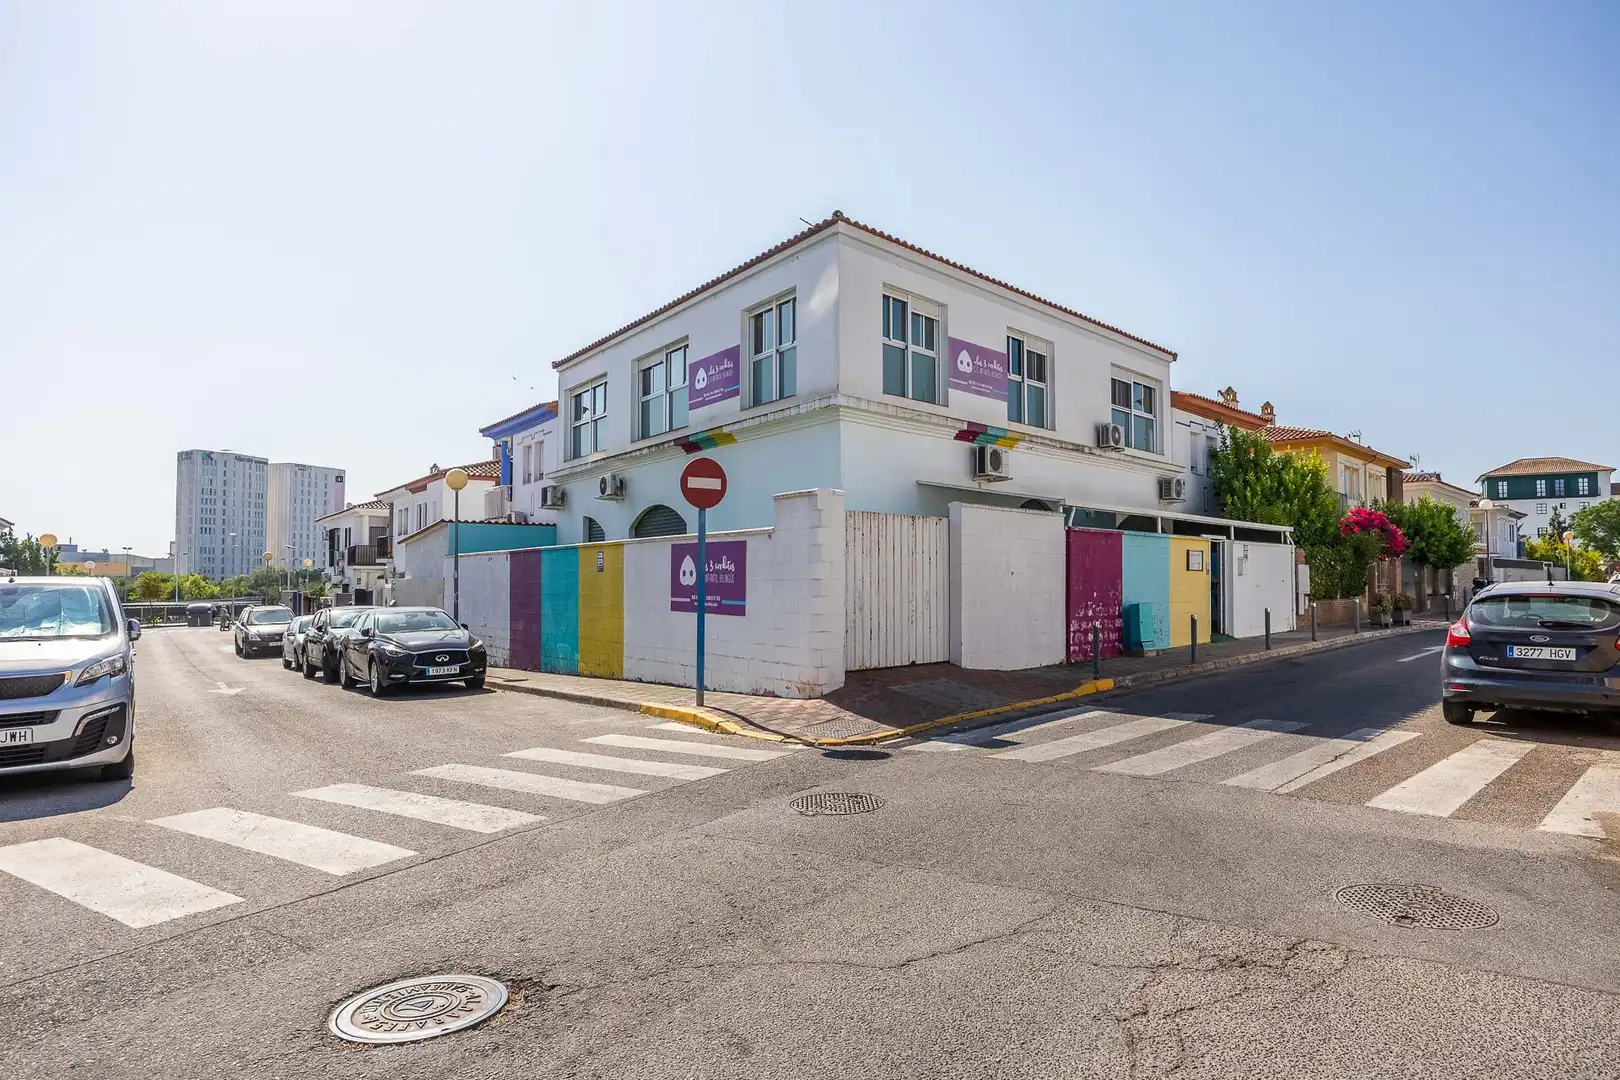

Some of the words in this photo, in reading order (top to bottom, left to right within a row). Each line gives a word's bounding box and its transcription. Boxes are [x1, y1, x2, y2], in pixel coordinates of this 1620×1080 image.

[709, 560, 714, 572] 3
[1516, 647, 1544, 658] 3277
[1549, 648, 1572, 659] HGV
[0, 731, 27, 743] JWH
